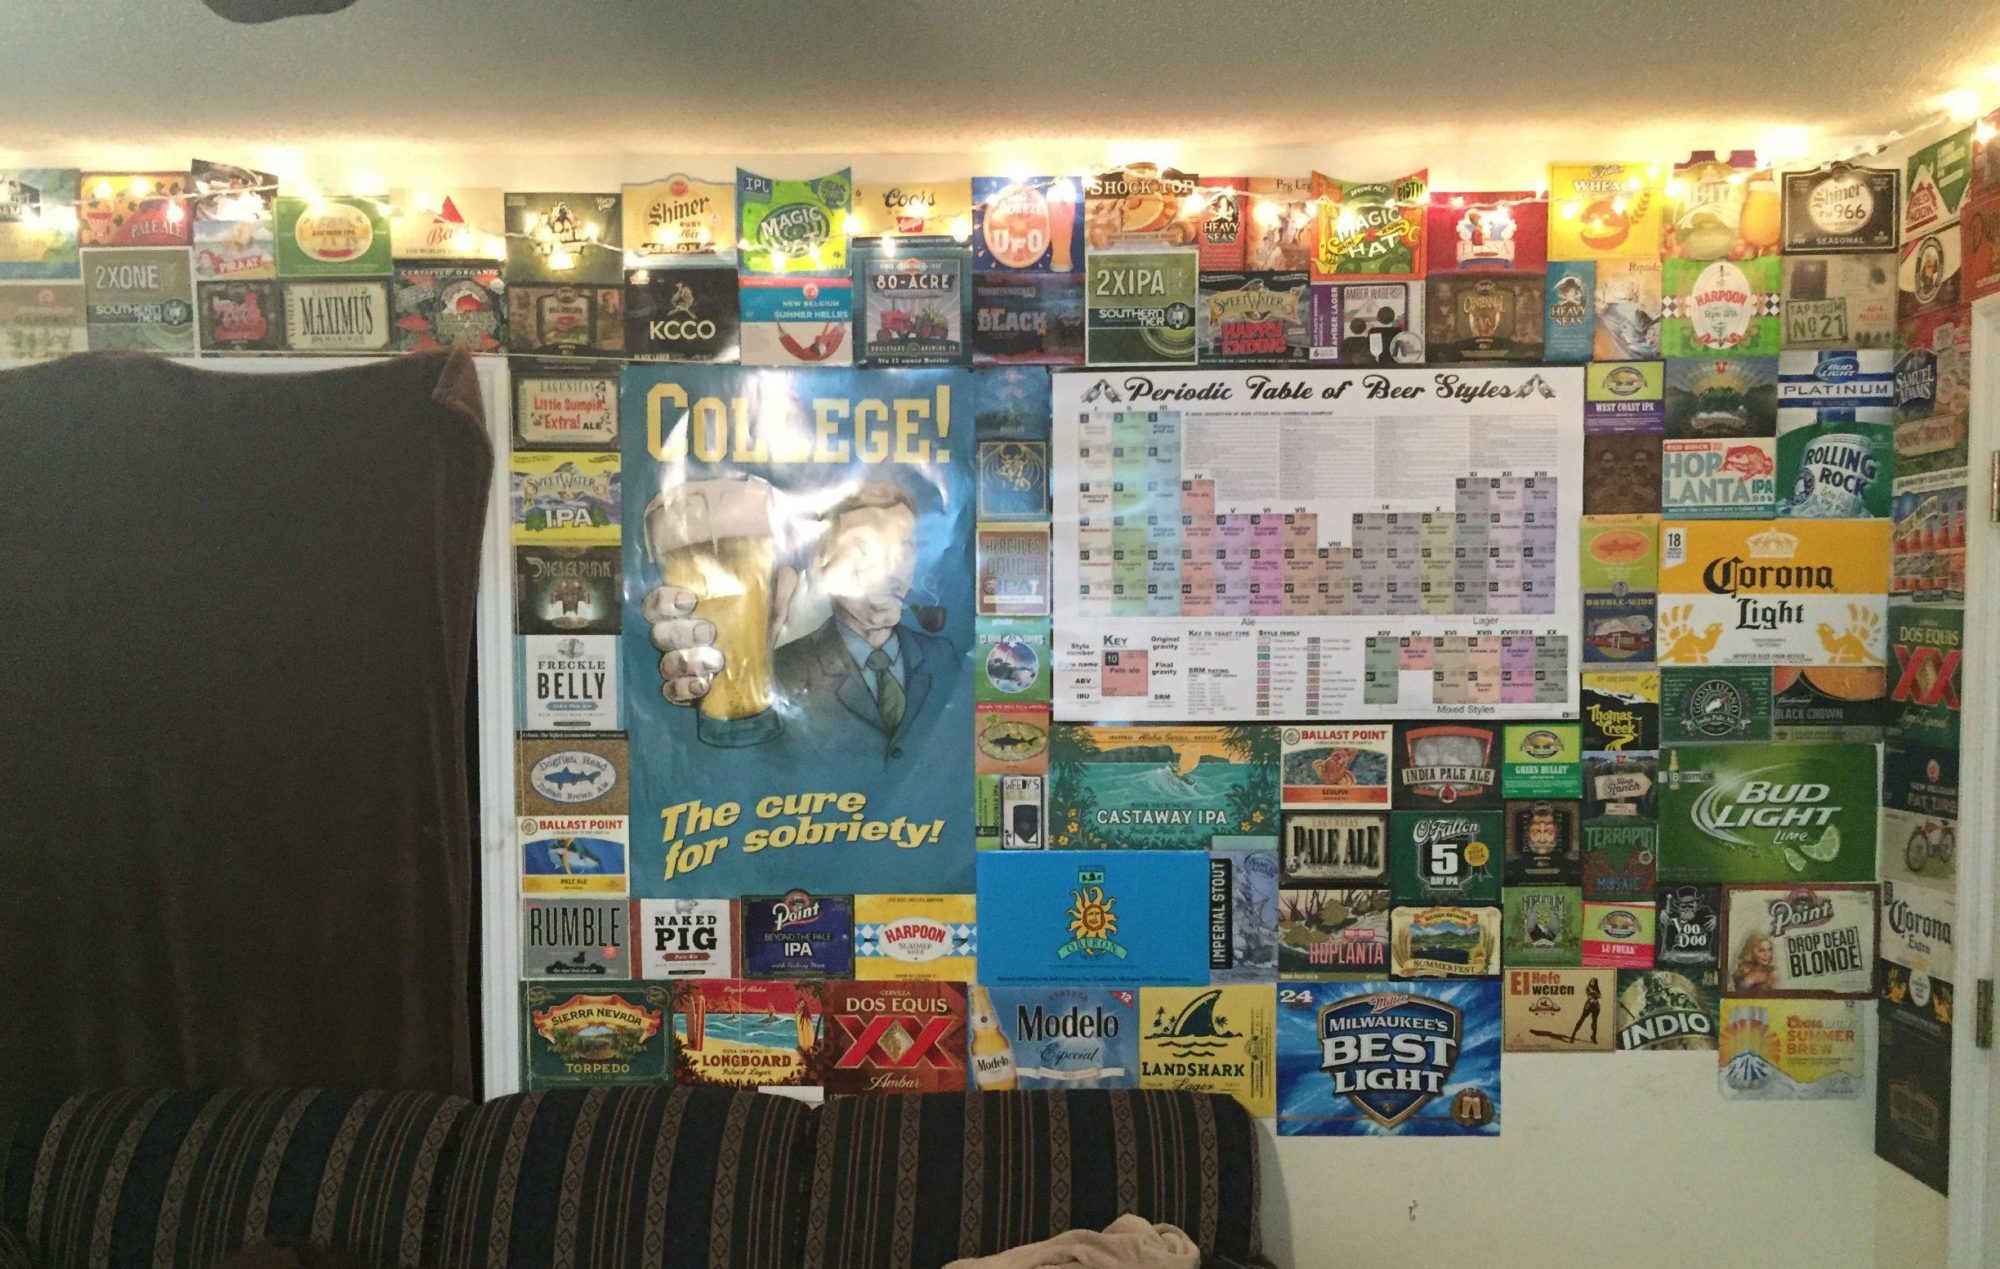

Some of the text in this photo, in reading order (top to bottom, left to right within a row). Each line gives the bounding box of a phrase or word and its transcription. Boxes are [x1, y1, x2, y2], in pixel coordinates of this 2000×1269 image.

[745, 177, 769, 193] IPL
[1090, 180, 1151, 196] SHOCK
[1812, 182, 1864, 208] Shiner
[648, 196, 710, 227] Shiner
[1836, 203, 1866, 219] 966
[131, 220, 160, 238] PALE
[761, 207, 822, 240] MAGIC
[1203, 223, 1239, 233] HEAVY
[1338, 207, 1402, 242] MAGIC
[993, 229, 1044, 253] UFO
[1207, 233, 1236, 242] SEAS
[1350, 233, 1400, 258] HAT
[1816, 237, 1864, 245] SEASONAL
[96, 265, 159, 289] 2XONE
[456, 268, 499, 276] ORGANIC
[1096, 270, 1165, 296] 2XIPA
[1696, 290, 1747, 306] HARPOON
[96, 305, 161, 314] SOUTHERN
[301, 295, 373, 336] MAXIMUS
[814, 311, 848, 319] HELLES
[1099, 309, 1165, 319] SOUTHERN
[1552, 305, 1587, 316] HEAVY
[977, 309, 1047, 331] BLACK
[1140, 317, 1165, 326] TIER
[1820, 313, 1845, 337] 21
[650, 321, 715, 340] KCCO
[1896, 366, 1933, 390] SAMUEL
[1124, 374, 1516, 403] Periodic Table of Beer Styles
[1784, 385, 1888, 395] PLATINUM
[1901, 383, 1931, 404] ADAMS
[534, 398, 562, 411] Little
[1596, 403, 1654, 411] WEST COAST IPA
[544, 415, 602, 430] Extra! ALE
[1665, 453, 1723, 478] HOP
[1805, 446, 1876, 480] ROLLING
[1664, 479, 1750, 503] LANTA
[1752, 480, 1773, 493] IPA
[1819, 468, 1867, 497] ROCK
[545, 509, 593, 528] IPA
[1668, 534, 1681, 547] 18
[1703, 557, 1835, 598] Corona
[1473, 617, 1499, 626] Lager
[1736, 598, 1804, 629] Light
[1900, 627, 1959, 645] DOS EQUIS
[538, 661, 605, 669] FRECKLE
[1107, 655, 1117, 663] 10
[538, 672, 605, 700] BELLY
[1468, 706, 1494, 714] Styles
[1586, 704, 1642, 722] Thomas
[1776, 708, 1843, 719] BLACK CROWN
[1302, 731, 1387, 740] BALLAST POINT
[1596, 721, 1638, 735] Creek
[540, 756, 608, 772] Dogfish Head
[1516, 766, 1568, 774] GREEN BULLET
[1406, 769, 1491, 782] INDIA PALE ALE
[1608, 782, 1641, 795] Ranch
[1736, 781, 1830, 803] BUD
[660, 791, 867, 844] The cure
[1097, 810, 1227, 824] CASTAWAY IPA
[1714, 805, 1842, 827] LIGHT
[539, 820, 624, 830] BALLAST POINT
[1413, 819, 1481, 845] O'Fallon
[664, 812, 945, 882] for sobriety!
[1585, 827, 1653, 850] TERRAPIN
[1431, 844, 1458, 875] 5
[655, 916, 717, 925] NAKED
[773, 902, 820, 931] Point
[1212, 862, 1226, 962] IMPERIAL STOUT
[1770, 900, 1834, 937] Point
[530, 907, 620, 947] RUMBLE
[1672, 919, 1700, 934] VOO
[1889, 900, 1951, 944] Corona
[655, 927, 717, 951] PIG
[885, 925, 946, 943] HARPOON
[1672, 934, 1707, 948] DOO
[1788, 928, 1857, 952] DROP DEAD
[785, 943, 812, 956] IPA
[1066, 939, 1117, 952] OBERON
[1602, 945, 1610, 953] LE
[1908, 935, 1931, 954] Extra
[1309, 943, 1384, 965] HOPLANTA
[1790, 946, 1860, 978] BLONDE
[1413, 959, 1475, 973] SUMMERFEST
[1511, 972, 1529, 995] El
[1532, 972, 1560, 983] Hefe
[1280, 990, 1313, 1003] 24
[1532, 985, 1574, 995] weizen
[847, 999, 947, 1012] DOS EQUIS
[552, 1008, 642, 1025] SIERRA NEVADA
[1017, 1006, 1119, 1042] Modelo
[1330, 1017, 1448, 1032] MILWAUKEE'S
[1622, 1012, 1710, 1050] INDIO
[1787, 1030, 1855, 1042] SUMMER
[834, 1015, 959, 1069] XX
[1786, 1043, 1833, 1055] BREW
[1038, 1043, 1099, 1062] Especial
[1321, 1034, 1456, 1068] BEST
[565, 1063, 630, 1073] TORPEDO
[703, 1055, 791, 1067] LONGBOARD
[977, 1057, 1009, 1071] Modelo
[1142, 1062, 1245, 1077] LANDSHARK
[864, 1073, 920, 1090] Ambar
[1172, 1079, 1215, 1091] Lager
[1335, 1069, 1444, 1093] LIGHT
